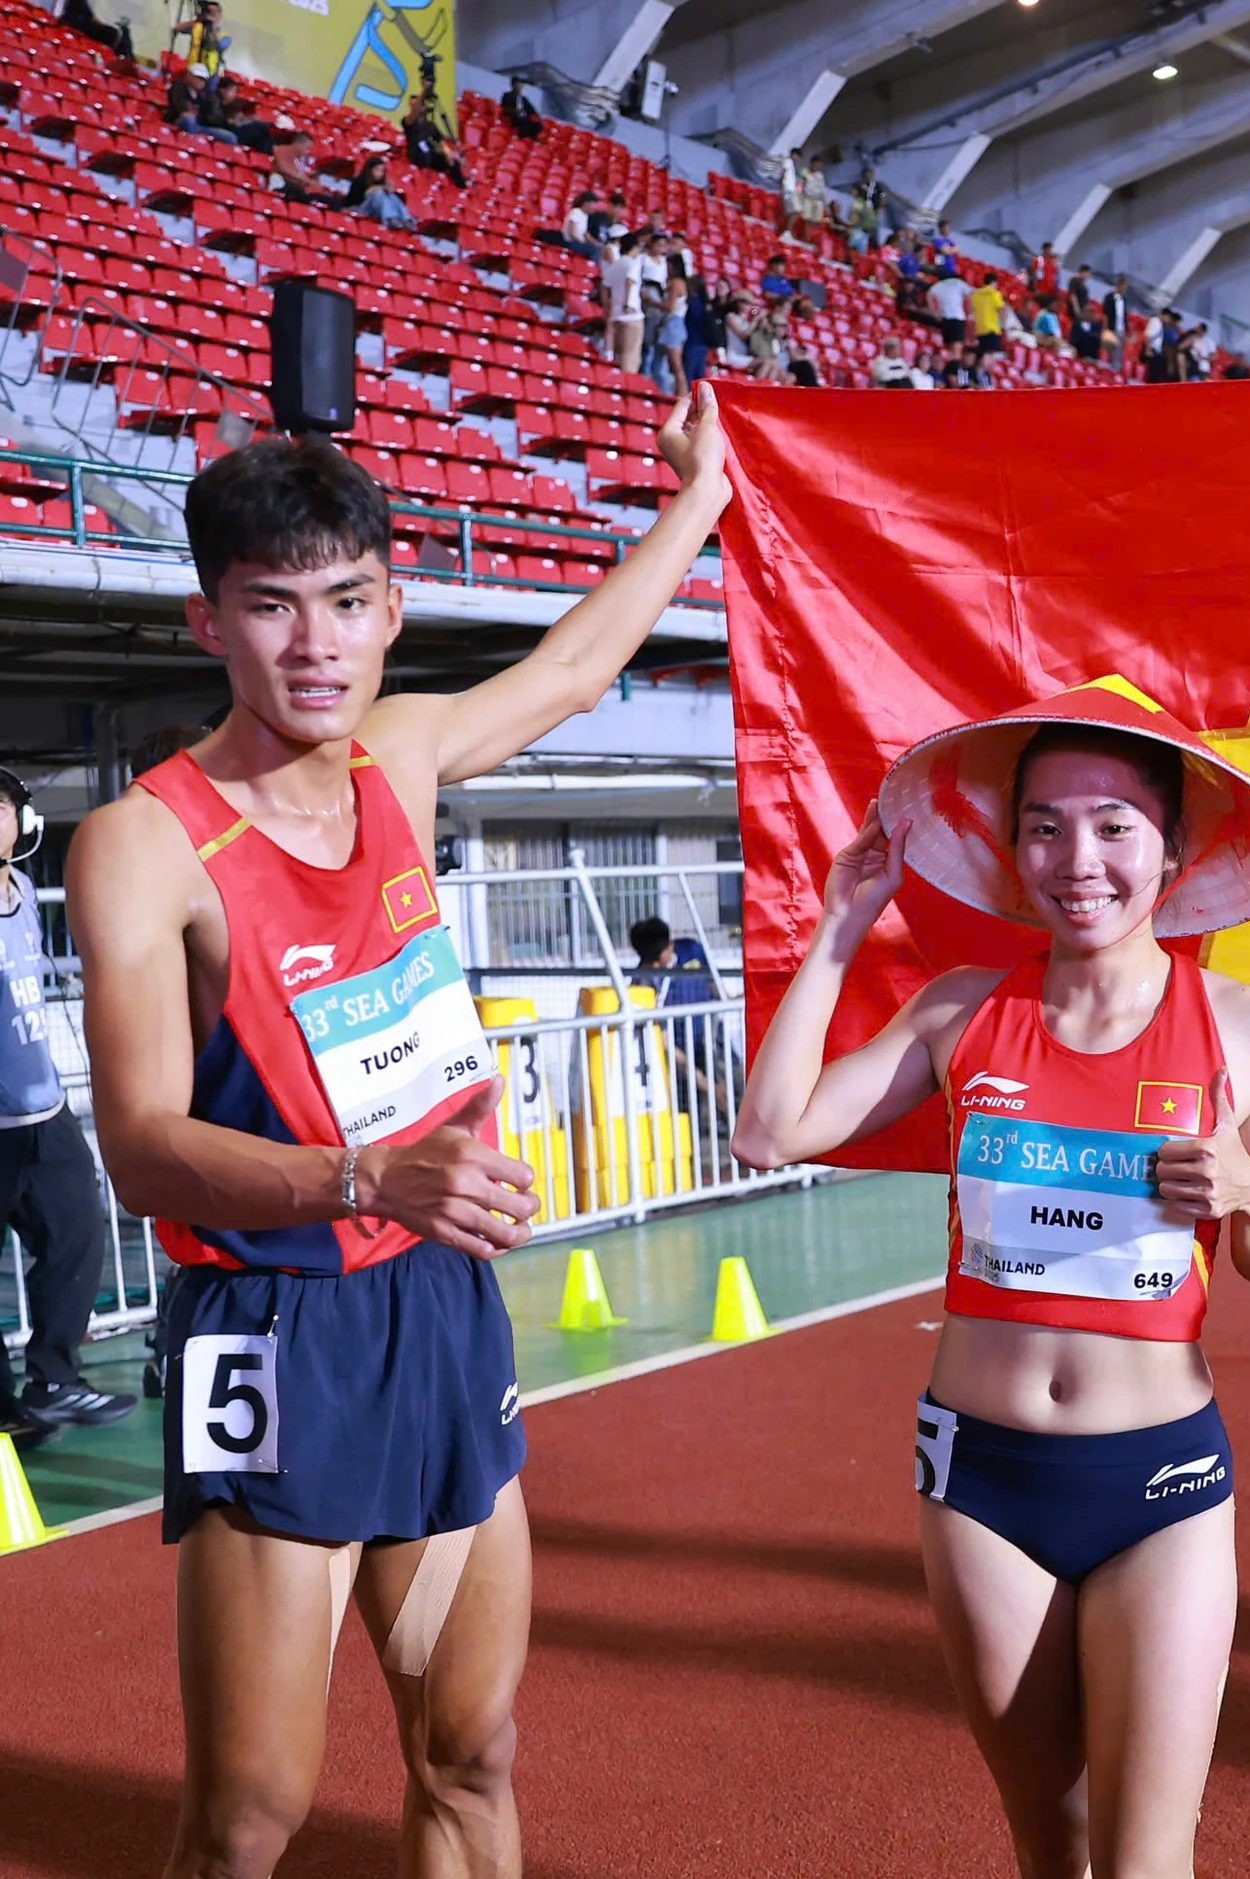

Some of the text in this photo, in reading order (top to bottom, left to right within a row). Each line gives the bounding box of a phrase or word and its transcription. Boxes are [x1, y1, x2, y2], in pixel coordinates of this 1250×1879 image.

[9, 975, 42, 1008] HB
[342, 989, 391, 1027] SEA
[391, 951, 435, 1005] GAMES
[360, 1031, 421, 1075] TUONG
[444, 1055, 479, 1082] 296
[961, 1095, 1027, 1111] LI-NING
[977, 1130, 1158, 1181] 33rd SEA GAME
[1030, 1206, 1104, 1230] HANG
[984, 1254, 1046, 1276] THAILAND
[1133, 1272, 1174, 1289] 649
[206, 1353, 268, 1455] 5
[1145, 1466, 1226, 1500] LI-NING
